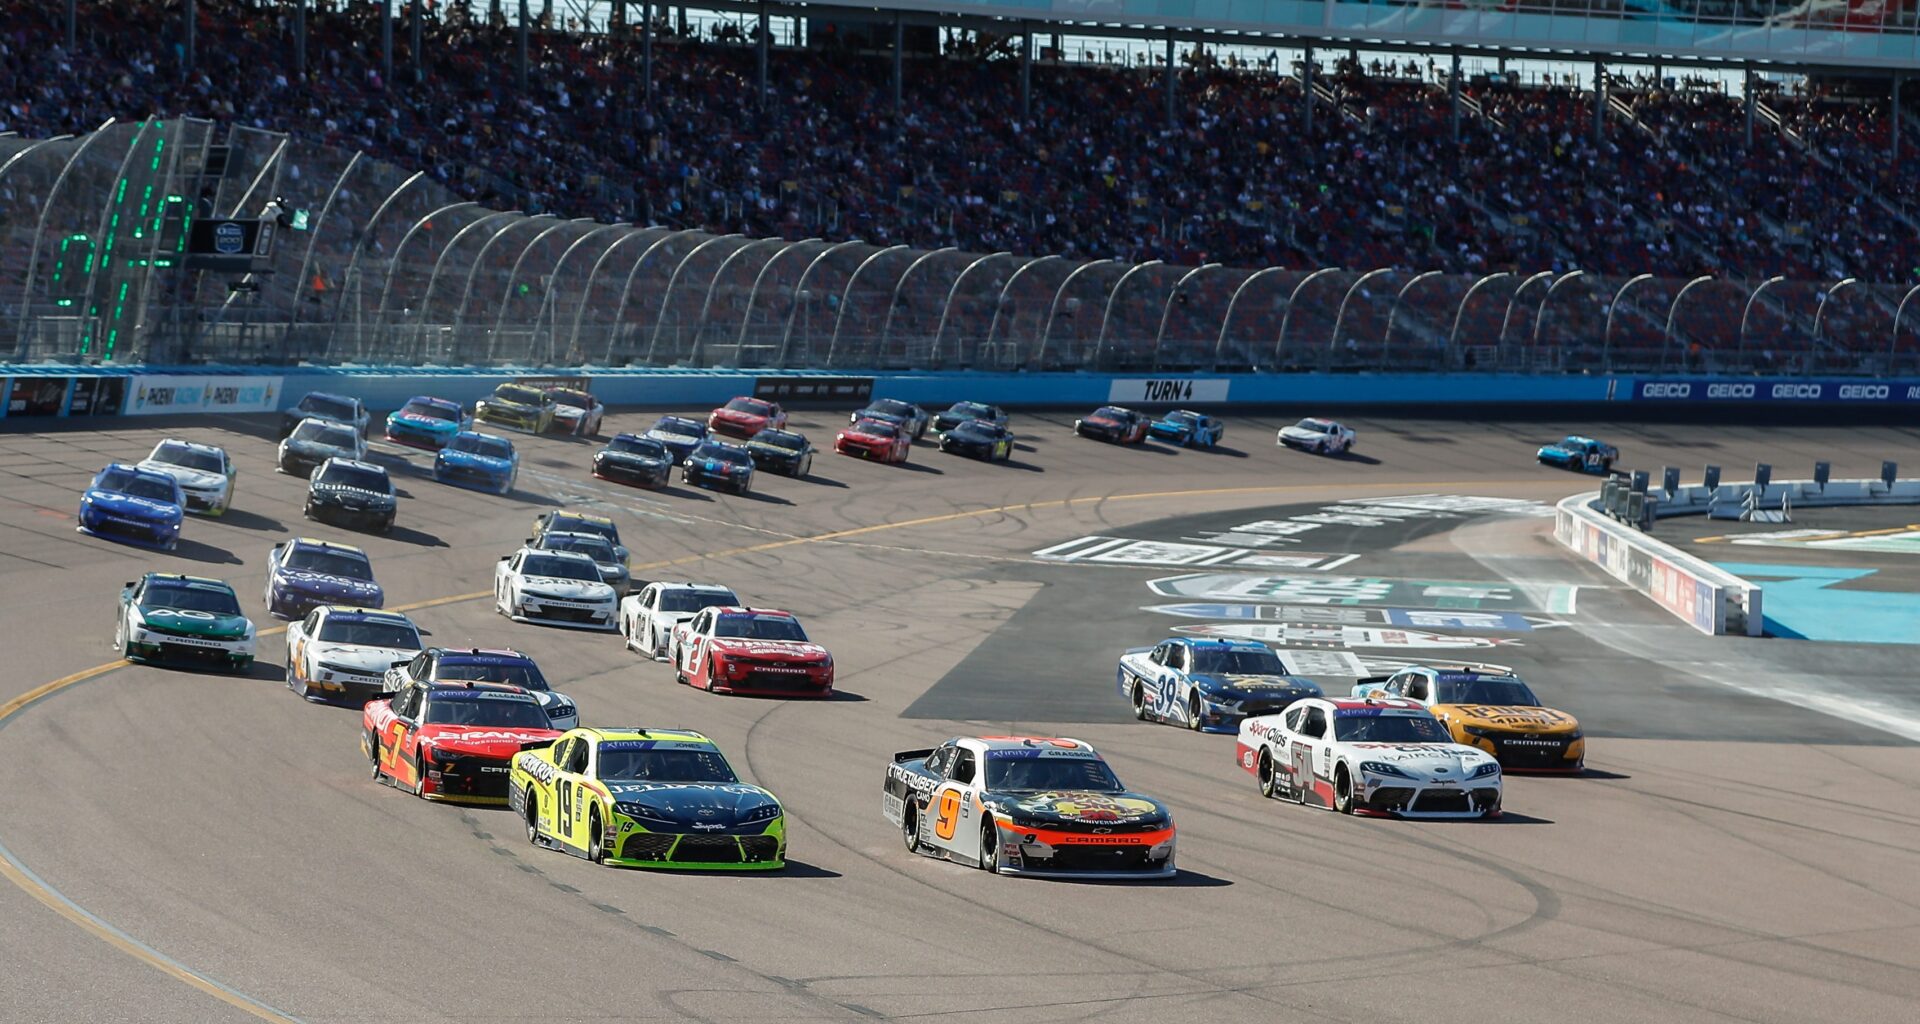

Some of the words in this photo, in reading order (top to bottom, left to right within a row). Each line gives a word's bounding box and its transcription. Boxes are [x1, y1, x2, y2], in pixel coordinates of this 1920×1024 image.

[1144, 381, 1185, 400] TURN
[1183, 381, 1192, 400] 4
[1643, 384, 1690, 397] GEICO
[1707, 384, 1755, 398] GEICO
[1772, 384, 1821, 398] GEICO
[1839, 385, 1889, 398] GEICO
[282, 569, 379, 590] VOYAGER
[544, 600, 590, 609] CAMARO
[472, 656, 502, 664] xfinity
[688, 637, 702, 672] 2
[728, 663, 736, 672] 2
[754, 666, 806, 674] CAMARO
[438, 690, 471, 698] xfinity
[1154, 674, 1177, 714] 39
[1267, 727, 1288, 748] Clips
[1503, 739, 1561, 747] CAMARO
[390, 723, 406, 769] 7
[606, 741, 645, 749] xfinity
[992, 750, 1030, 758] xfinity
[444, 762, 455, 773] 7
[1290, 740, 1315, 790] 54
[893, 764, 938, 795] TRUETIMBER
[1429, 777, 1457, 786] Supra
[916, 790, 931, 802] CAMO
[555, 777, 573, 839] 19
[935, 787, 961, 840] 9
[620, 821, 635, 832] 19
[691, 822, 727, 832] Supra
[1022, 833, 1037, 844] 9
[1065, 836, 1141, 844] CAMARO
